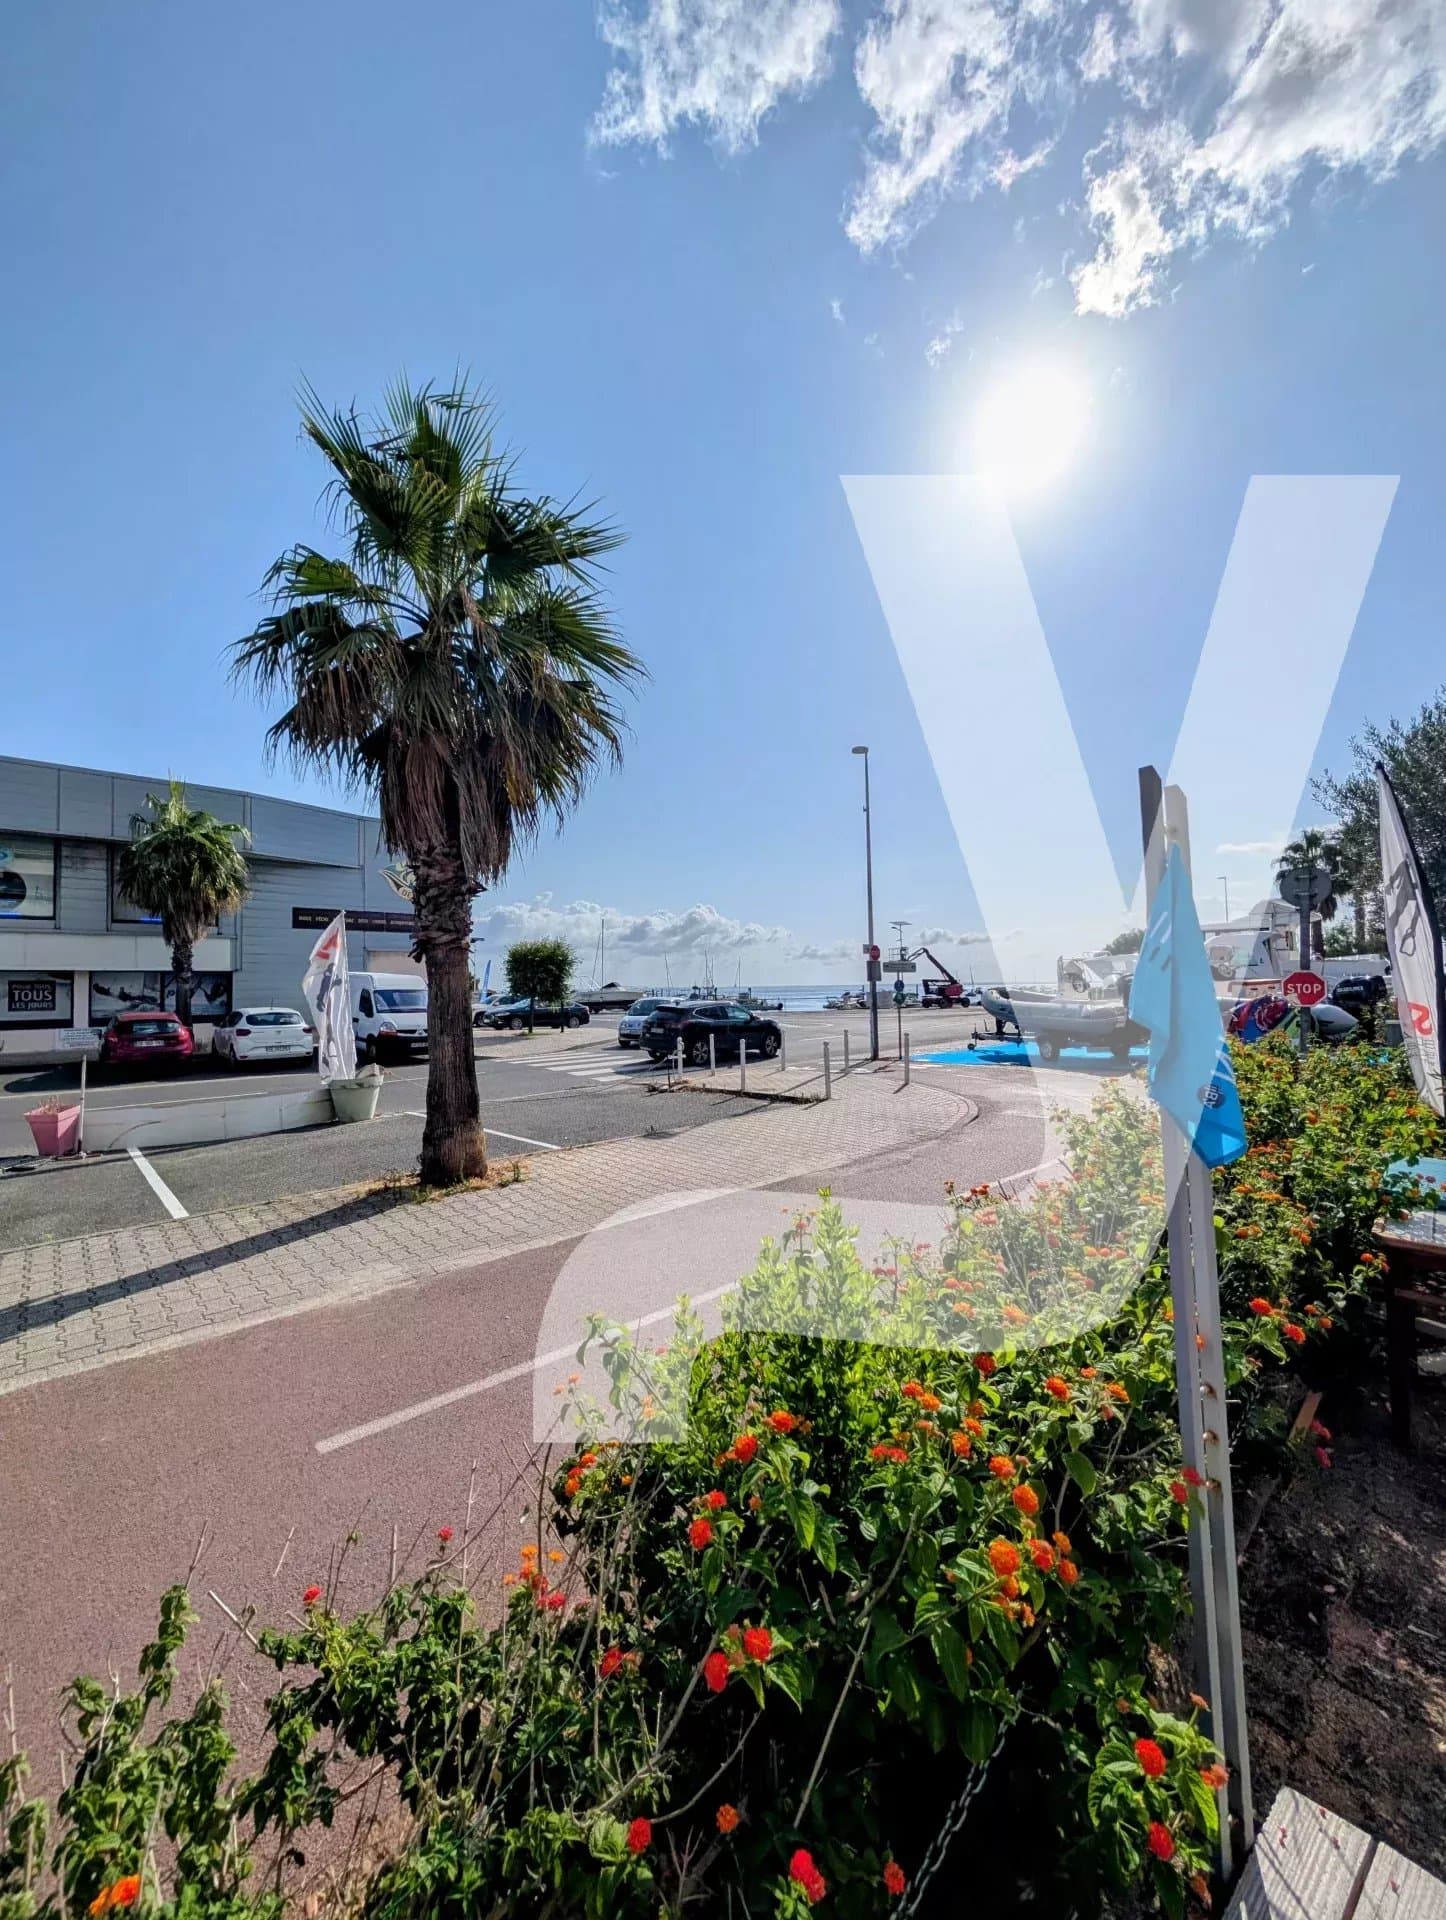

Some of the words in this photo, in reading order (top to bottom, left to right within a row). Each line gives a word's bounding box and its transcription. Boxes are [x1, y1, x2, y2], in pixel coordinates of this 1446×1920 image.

[1287, 983, 1322, 995] STOP
[13, 990, 53, 1001] TOUS
[12, 1001, 26, 1009] LES
[27, 1001, 53, 1010] JOURS
